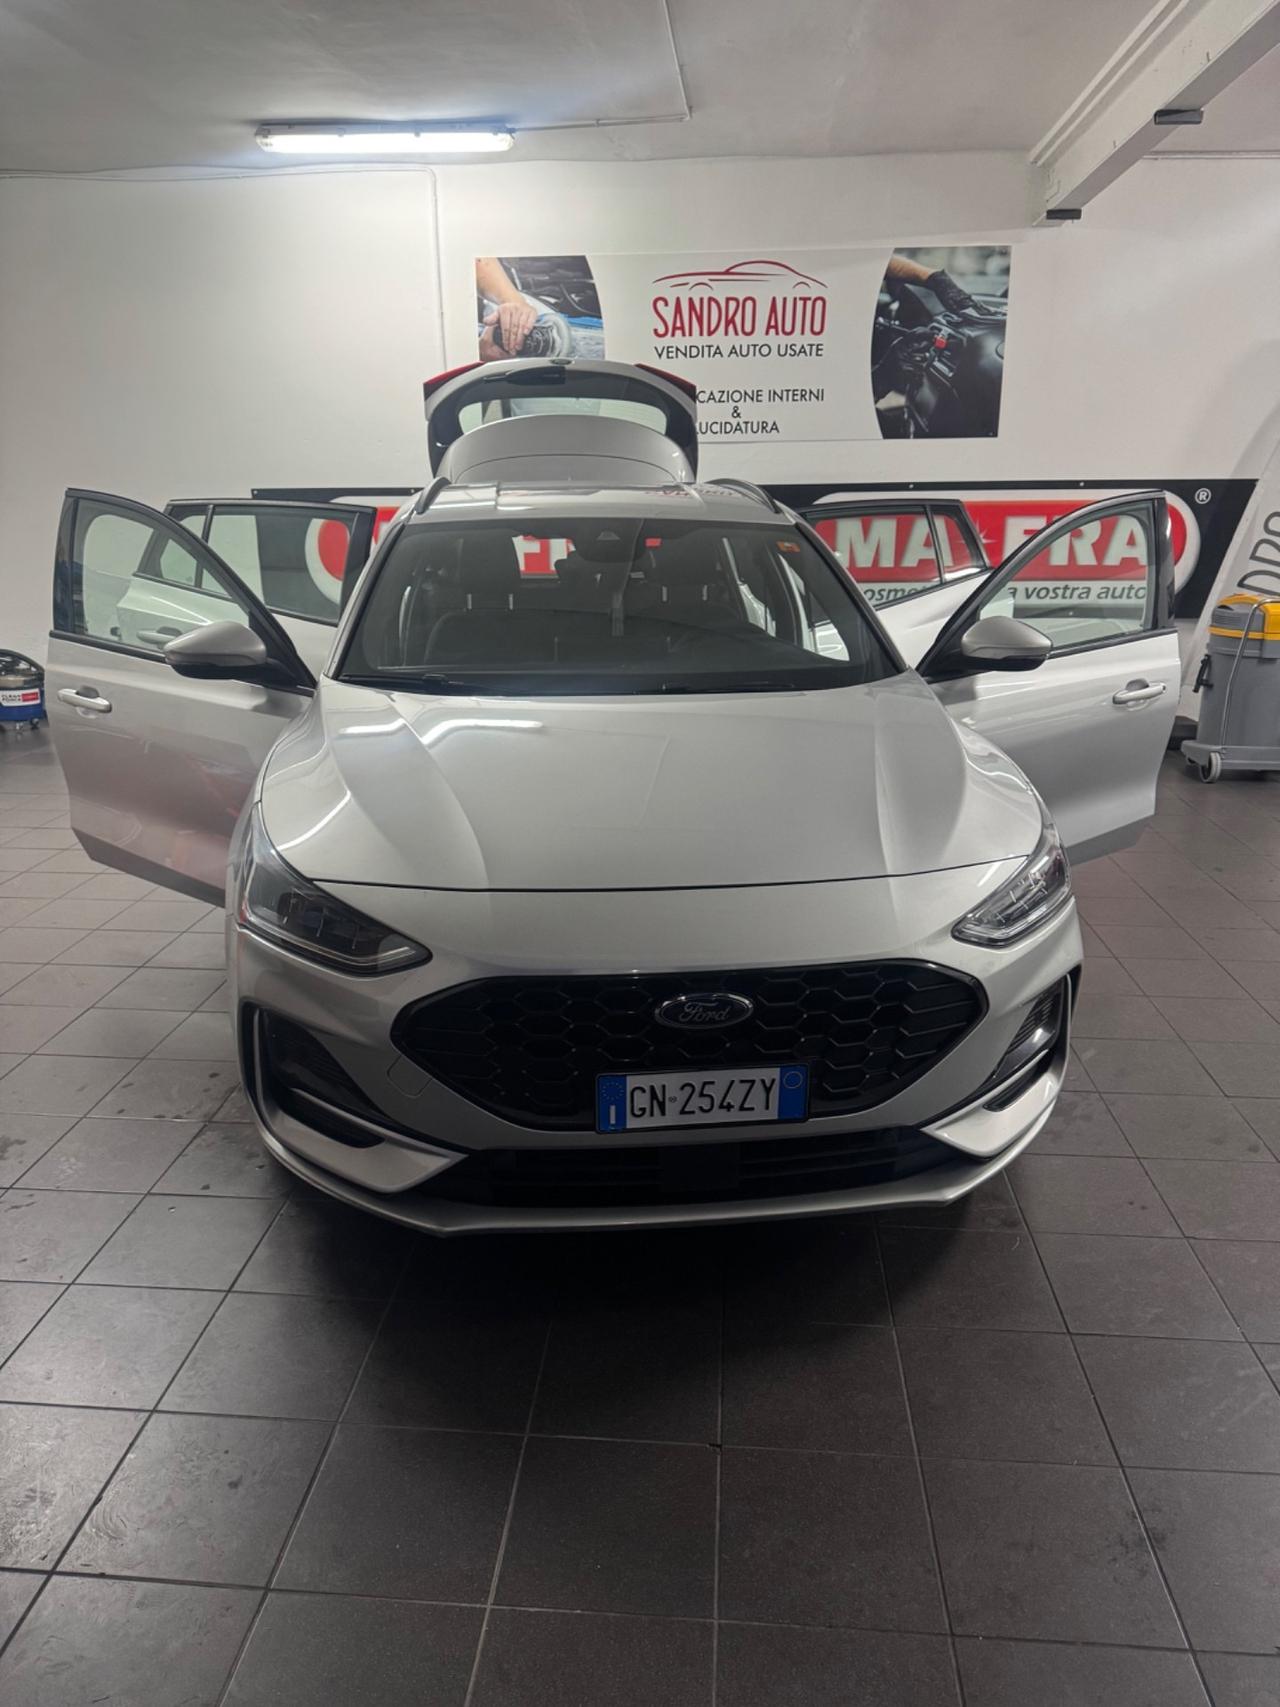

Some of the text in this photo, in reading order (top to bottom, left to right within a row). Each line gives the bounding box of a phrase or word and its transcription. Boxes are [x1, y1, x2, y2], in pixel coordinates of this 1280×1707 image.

[652, 296, 827, 338] SANDRO AUTO
[654, 343, 824, 359] VENDITA AUTO USATE
[768, 388, 825, 402] INTERNI
[731, 405, 742, 419] &
[696, 420, 780, 435] UCIDATURA
[1024, 583, 1091, 600] vostra
[679, 1001, 732, 1022] Ford
[630, 1077, 777, 1119] GN 254ZY
